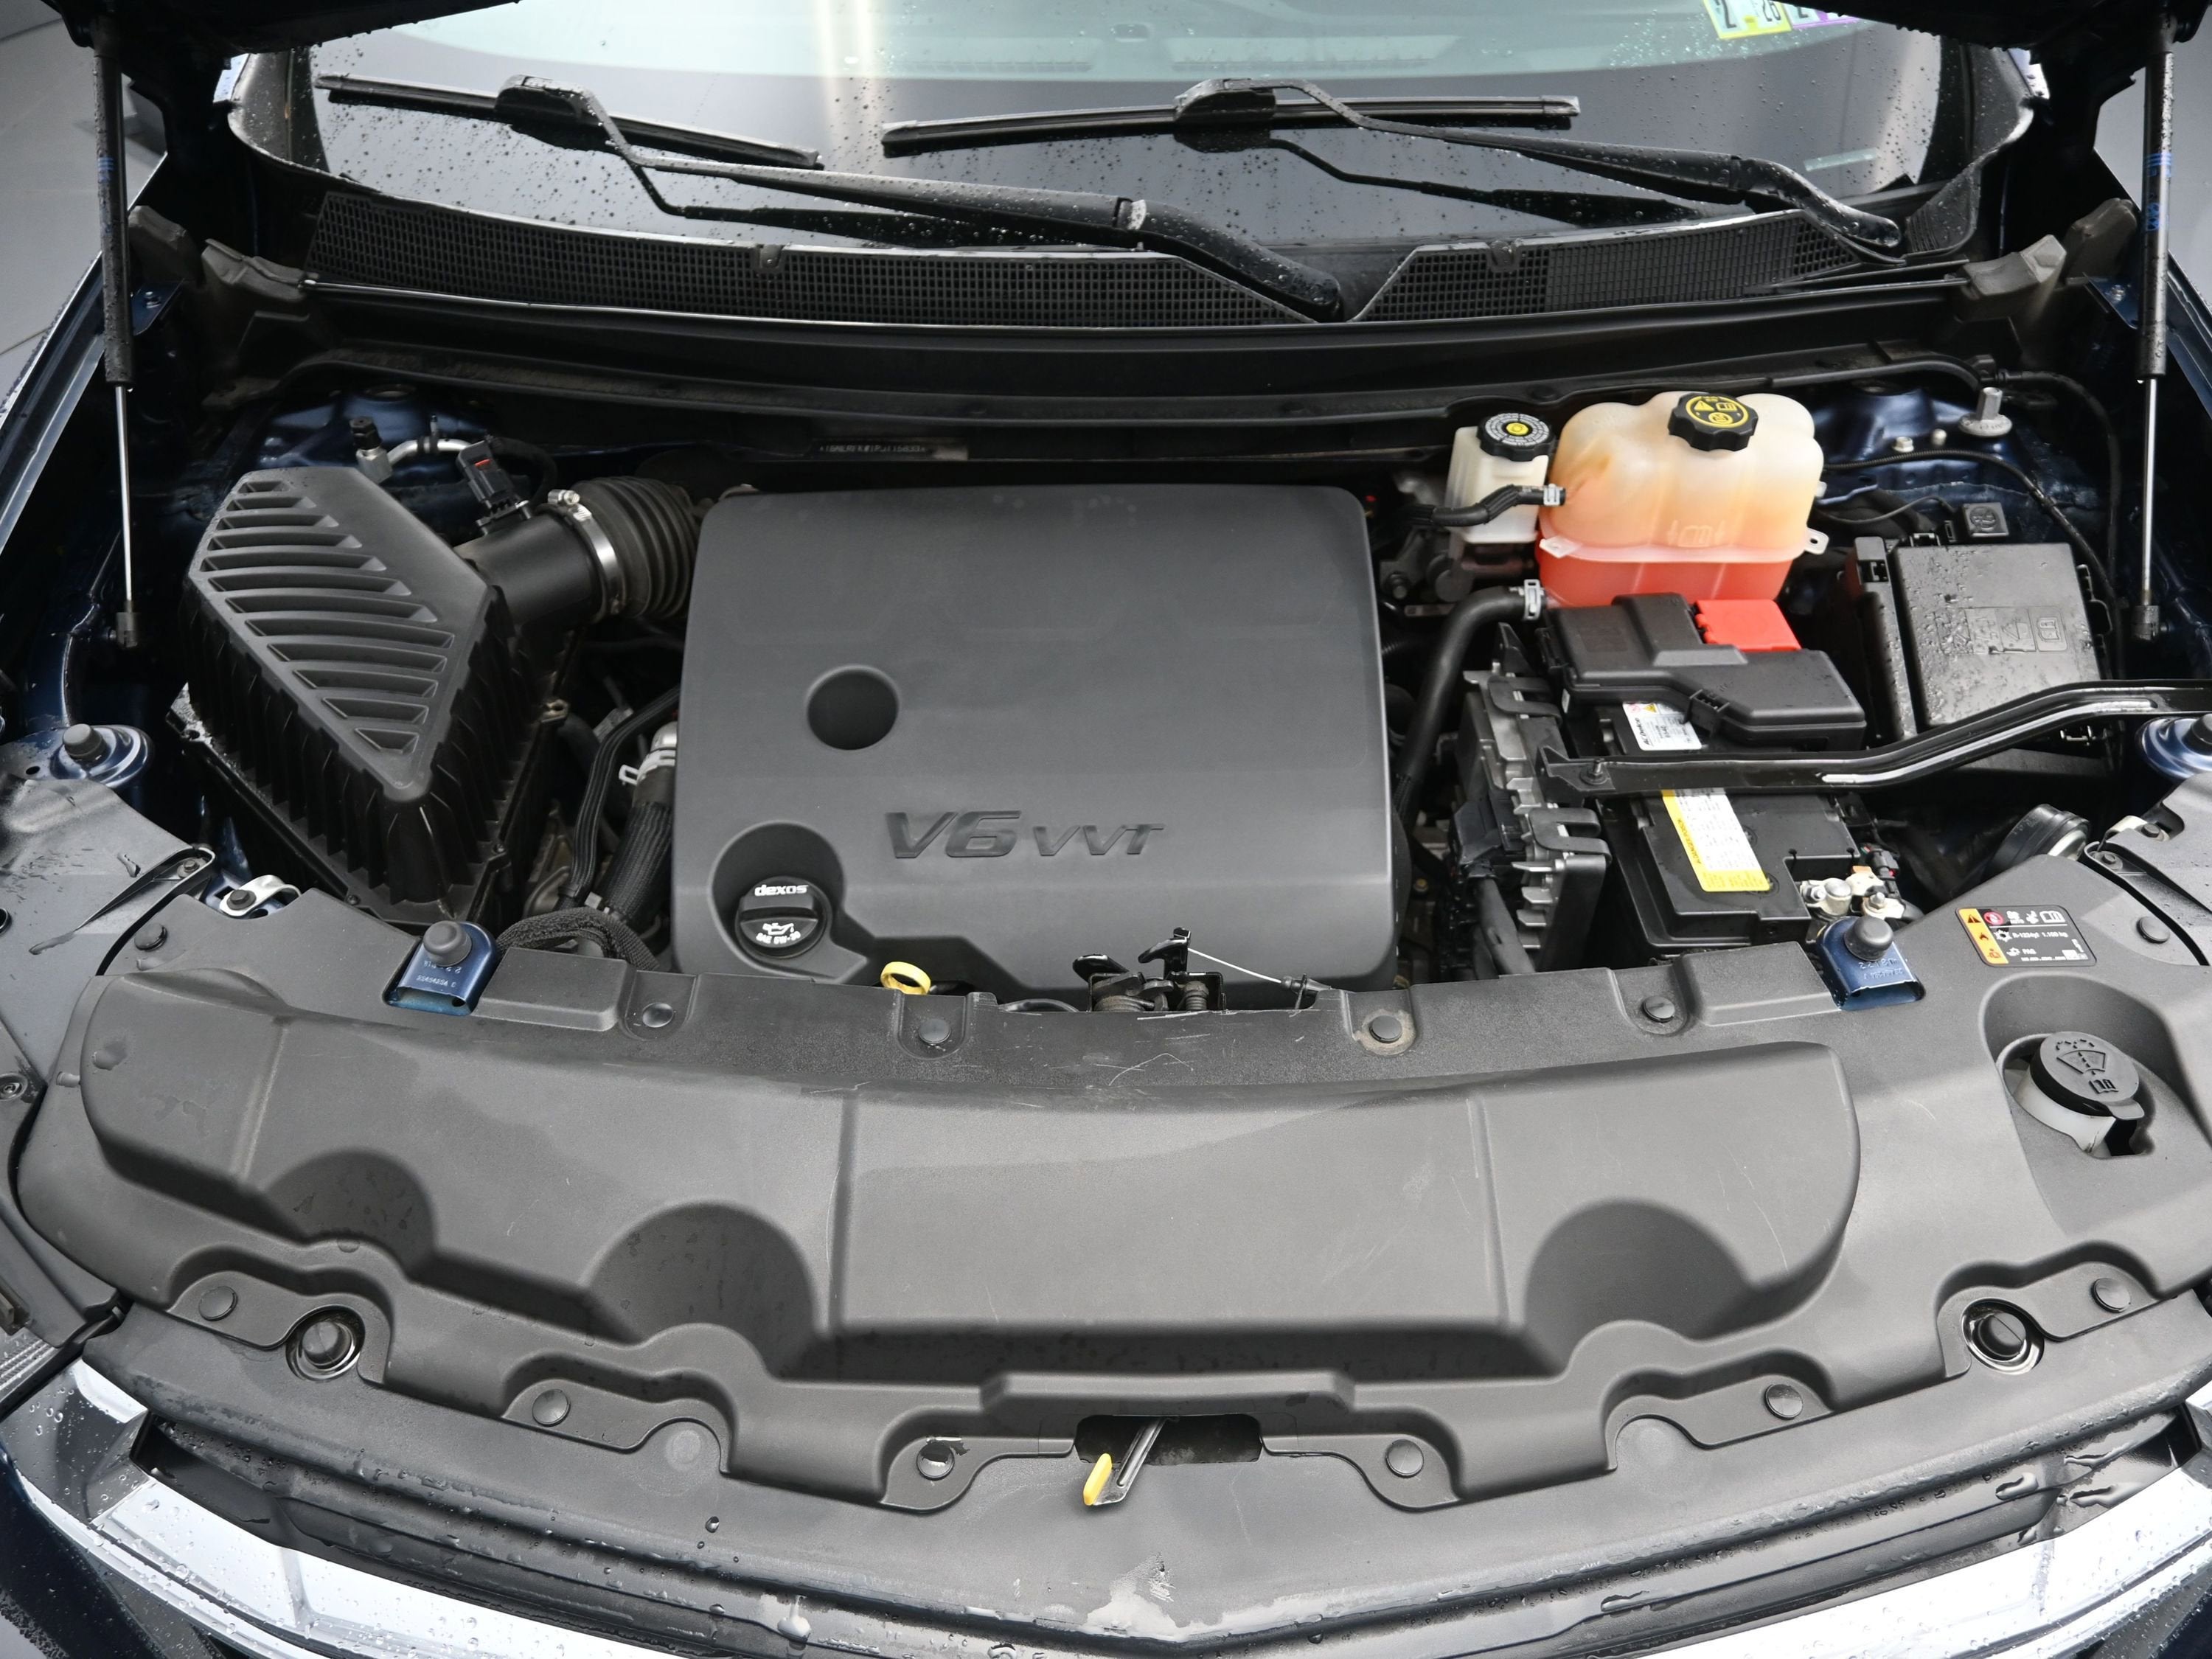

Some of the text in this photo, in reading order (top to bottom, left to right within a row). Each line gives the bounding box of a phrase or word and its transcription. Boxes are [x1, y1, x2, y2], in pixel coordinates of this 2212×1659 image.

[886, 810, 1165, 859] V6 VVT
[754, 884, 809, 897] dexos
